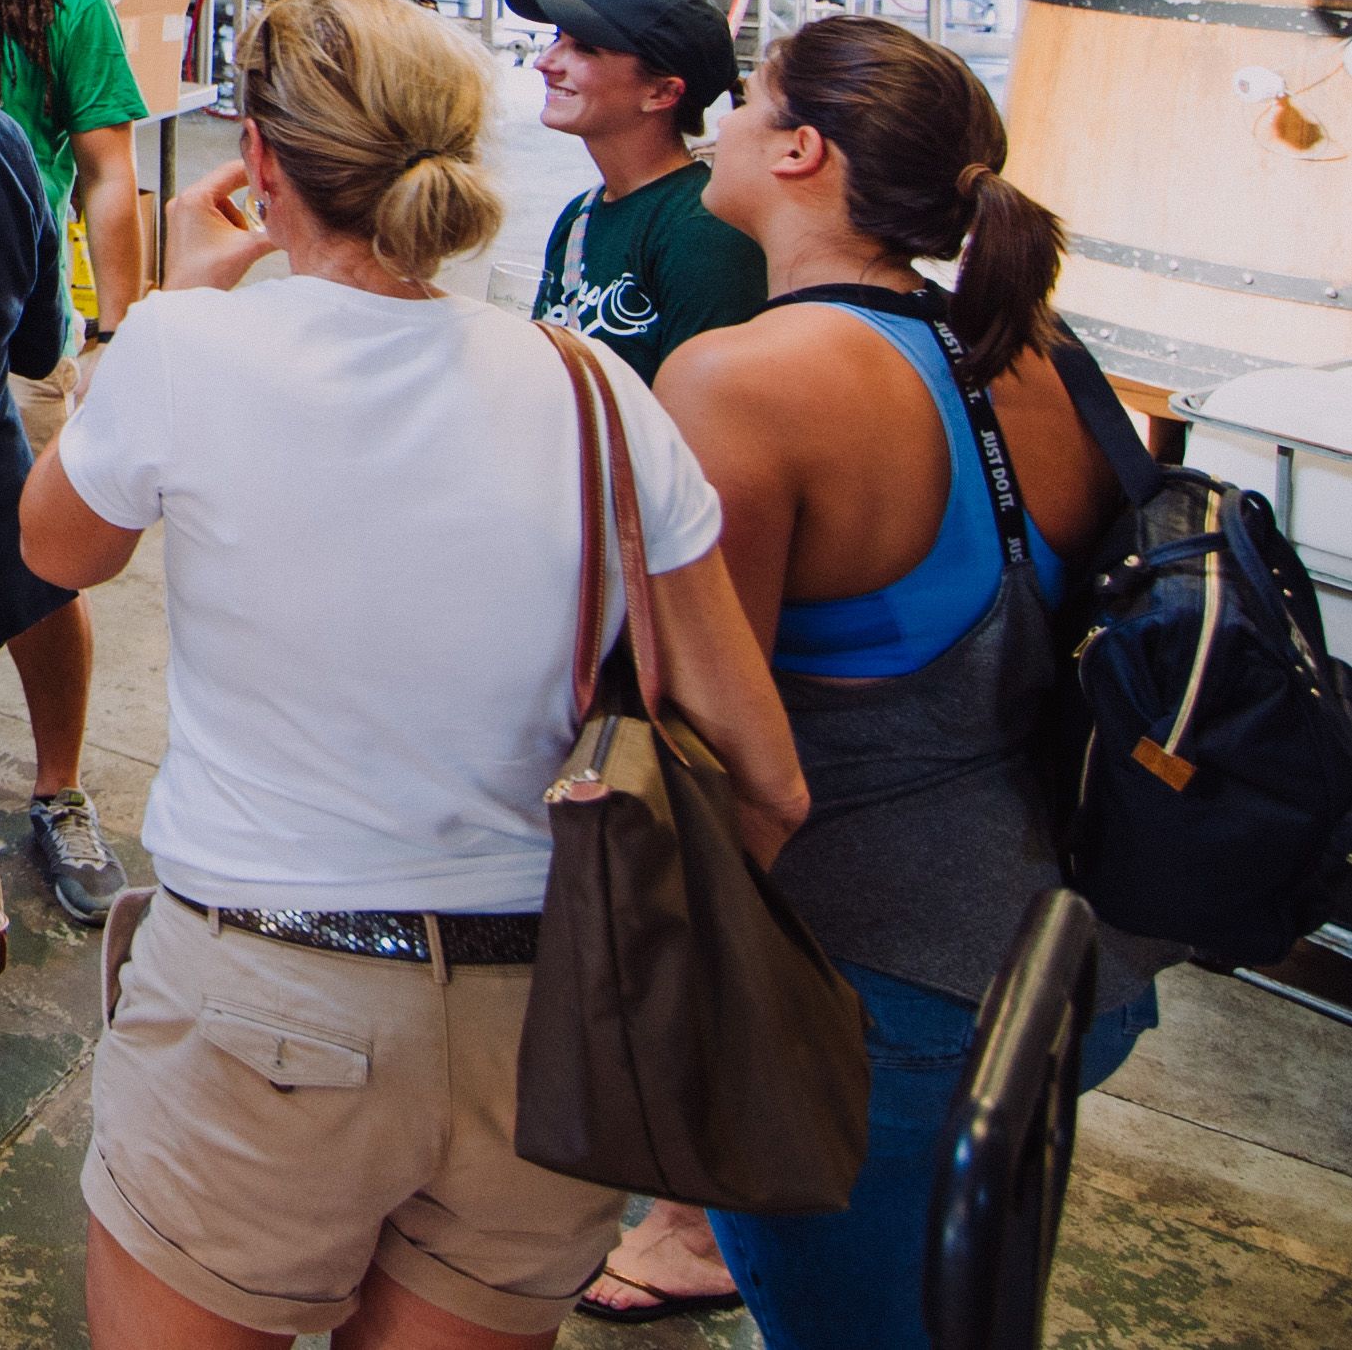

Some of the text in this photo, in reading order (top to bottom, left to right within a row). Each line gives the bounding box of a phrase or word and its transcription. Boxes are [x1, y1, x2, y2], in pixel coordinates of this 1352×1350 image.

[933, 320, 964, 354] JUST
[980, 430, 1015, 512] JUST DO IT.
